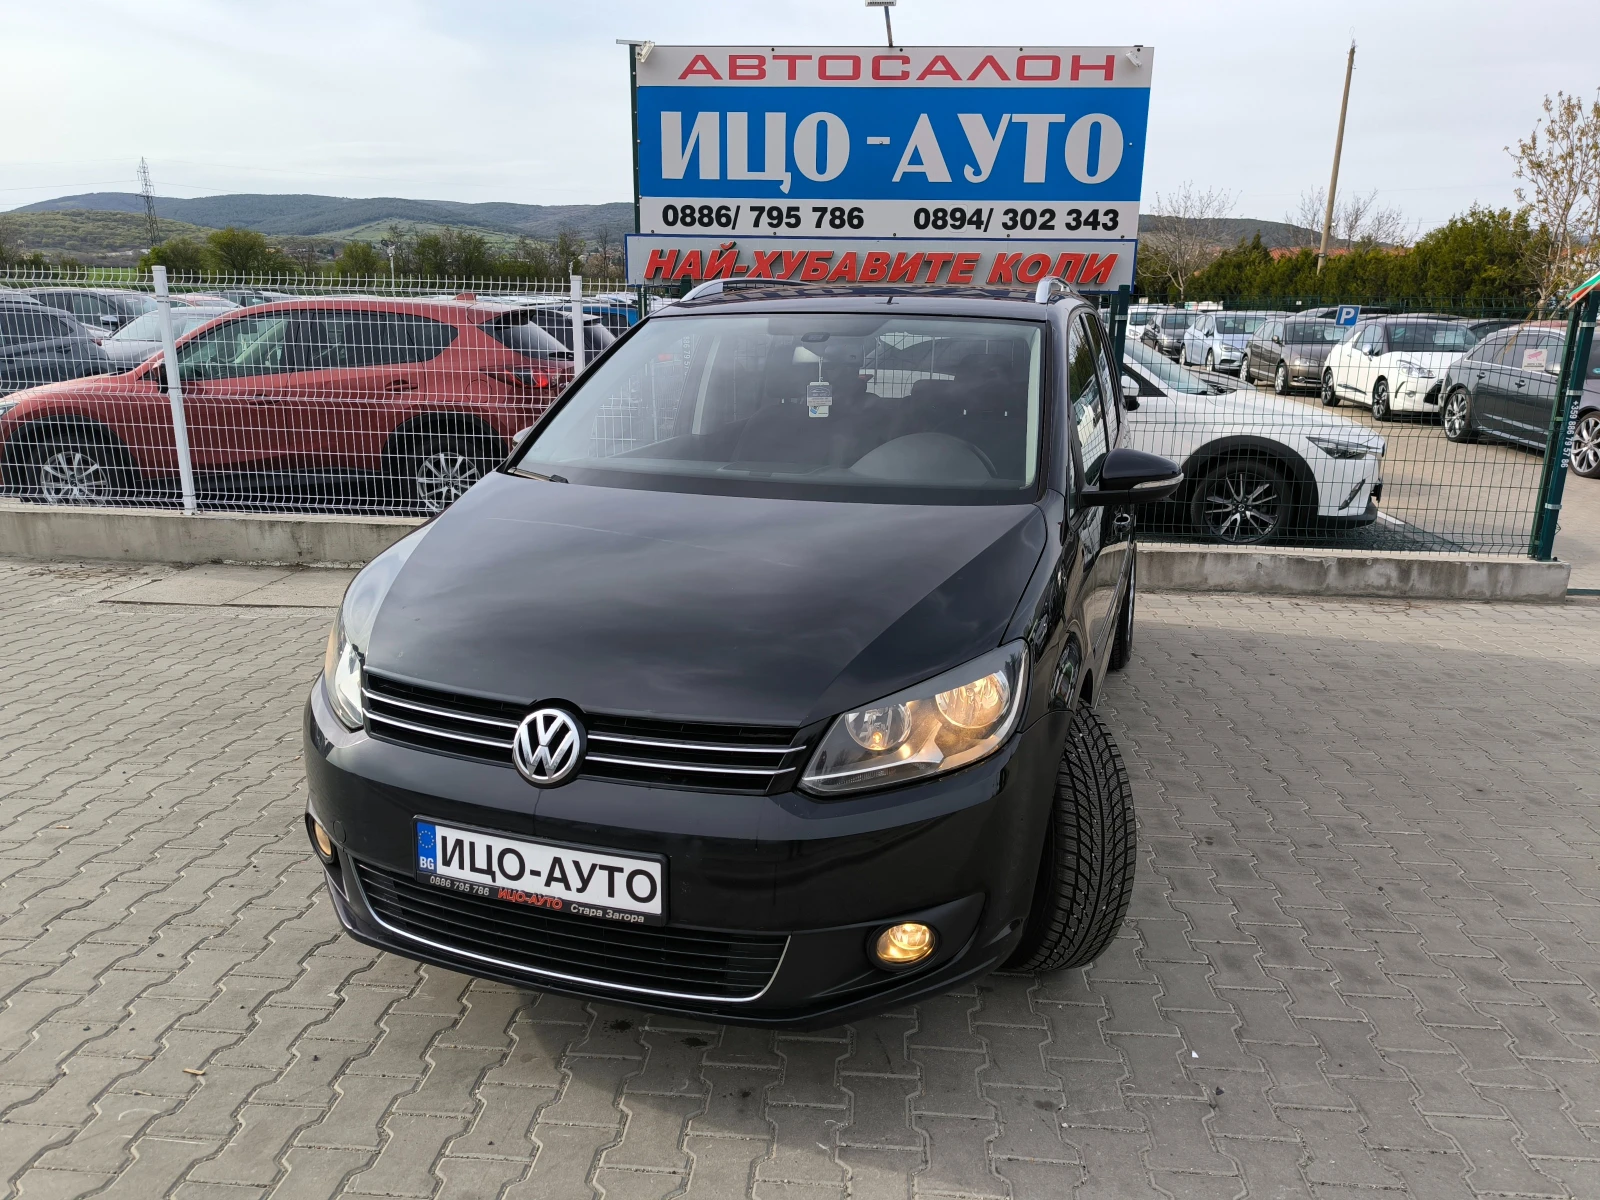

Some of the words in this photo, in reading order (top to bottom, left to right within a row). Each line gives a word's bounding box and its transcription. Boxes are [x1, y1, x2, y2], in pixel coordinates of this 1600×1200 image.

[678, 54, 1116, 81] АВТОСАЛОН
[661, 204, 741, 231] 0886/
[749, 205, 802, 229] 795
[811, 206, 865, 230] 786
[913, 207, 995, 233] 0894/
[1001, 207, 1057, 231] 302
[1064, 208, 1120, 232] 343
[644, 241, 982, 285] НАЙ-ХУБАВИТЕ
[1339, 307, 1355, 324] P
[1566, 421, 1577, 435] 886
[1562, 447, 1572, 457] 57
[1564, 437, 1574, 446] 79
[1560, 459, 1570, 468] 86
[514, 709, 580, 784] VW
[419, 856, 435, 870] BG
[441, 835, 658, 904] ИЦО-АУТО
[430, 876, 451, 888] 0886
[453, 881, 470, 892] 795
[472, 885, 490, 896] 786
[497, 887, 563, 910] ИЦО-АУТО
[570, 903, 603, 917] Стара
[605, 909, 645, 923] Загора
